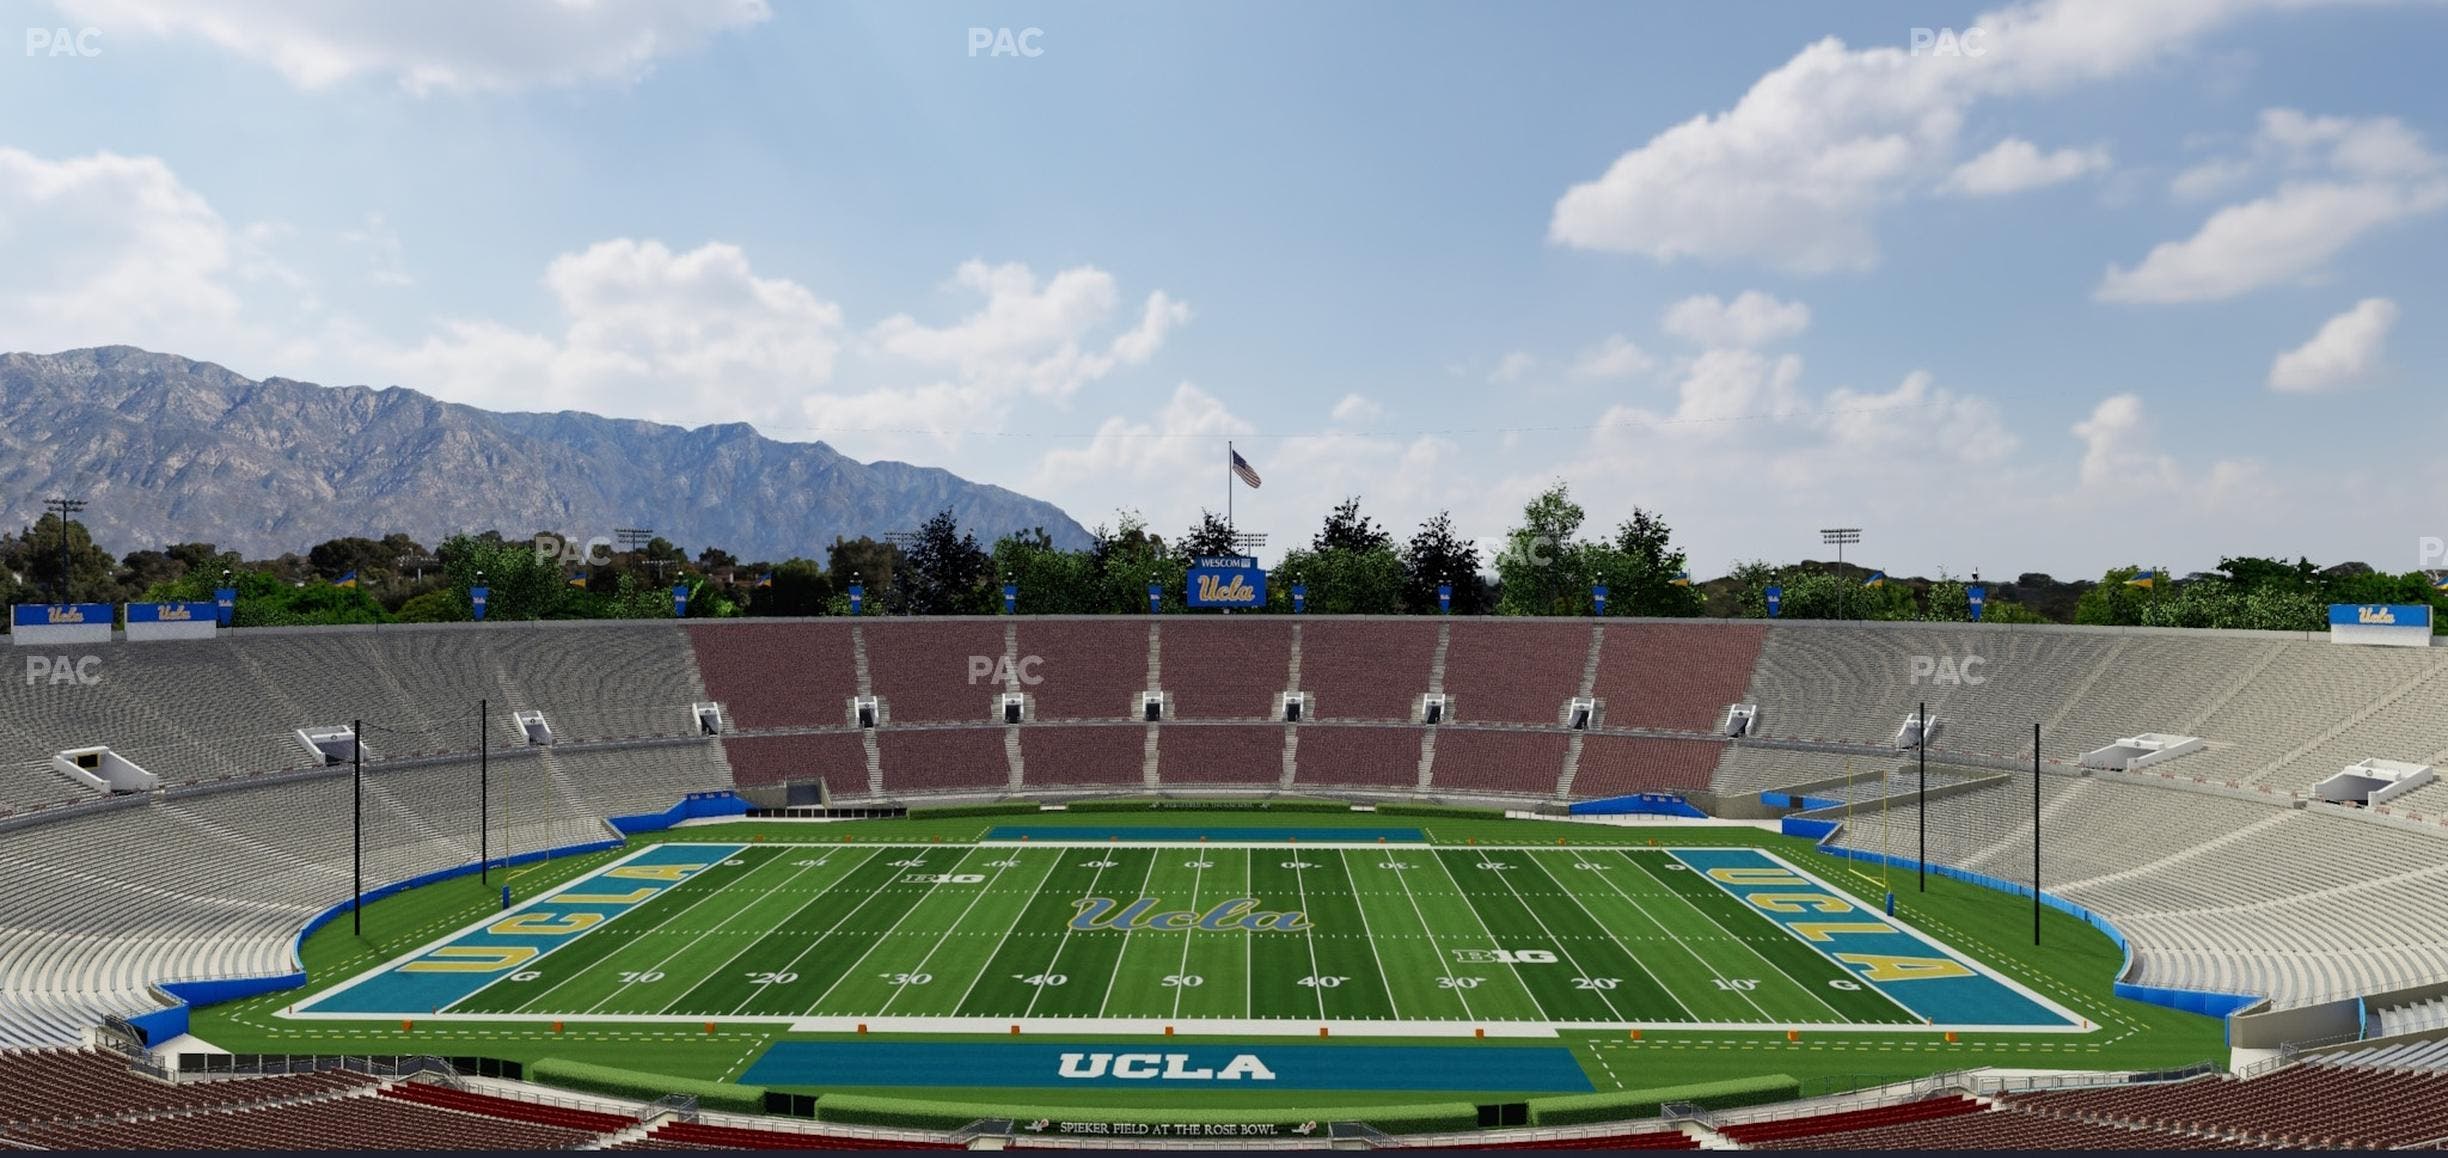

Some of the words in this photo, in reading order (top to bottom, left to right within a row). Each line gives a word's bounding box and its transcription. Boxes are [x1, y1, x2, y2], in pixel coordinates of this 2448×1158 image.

[1201, 558, 1240, 567] WESCOM
[395, 863, 709, 973] UCLA
[1706, 868, 1978, 981] UCLA
[510, 971, 542, 982] G
[618, 971, 665, 983] 10
[749, 972, 798, 984] 20
[889, 973, 932, 985] 30
[1023, 974, 1068, 986] 40
[1161, 975, 1203, 987] 50
[1297, 976, 1340, 988] 40
[1436, 977, 1479, 989] 30
[1571, 978, 1617, 990] 20
[1711, 978, 1758, 990] 10
[1828, 979, 1862, 990] G
[1058, 1053, 1276, 1080] UCLA
[1060, 1122, 1109, 1134] SPIEKER
[1113, 1123, 1149, 1135] FIELD
[1152, 1124, 1170, 1135] AT
[1174, 1124, 1200, 1135] THE
[1204, 1124, 1237, 1135] ROSE
[1241, 1123, 1278, 1135] BOWL
